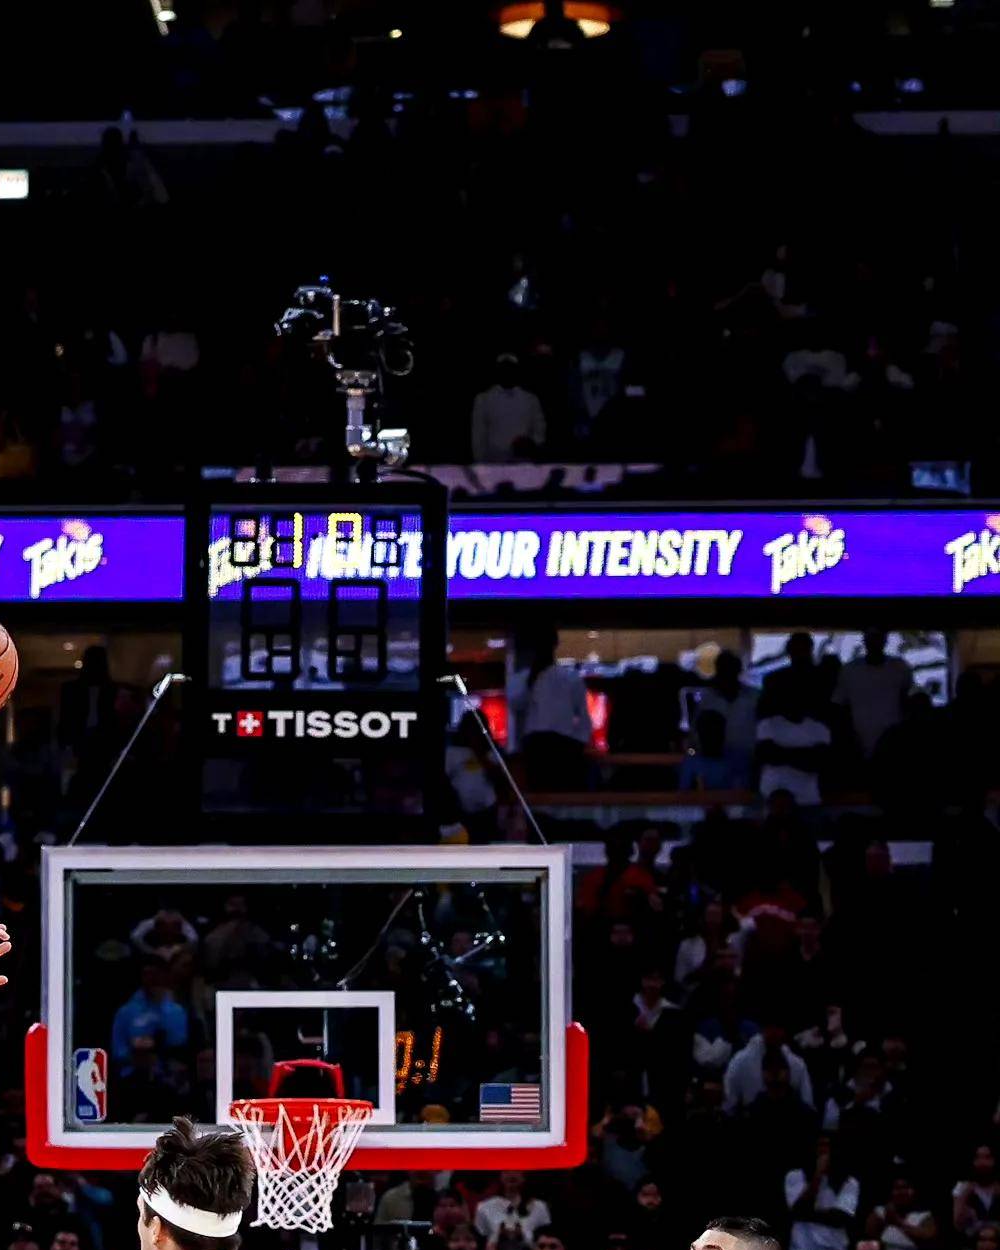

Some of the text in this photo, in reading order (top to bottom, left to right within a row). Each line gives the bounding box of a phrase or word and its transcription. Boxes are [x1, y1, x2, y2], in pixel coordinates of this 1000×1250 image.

[23, 534, 103, 599] Takis
[446, 530, 541, 580] YOUR
[545, 529, 743, 577] INTENSITY
[763, 529, 845, 594] Takis
[267, 711, 417, 738] TISSOT
